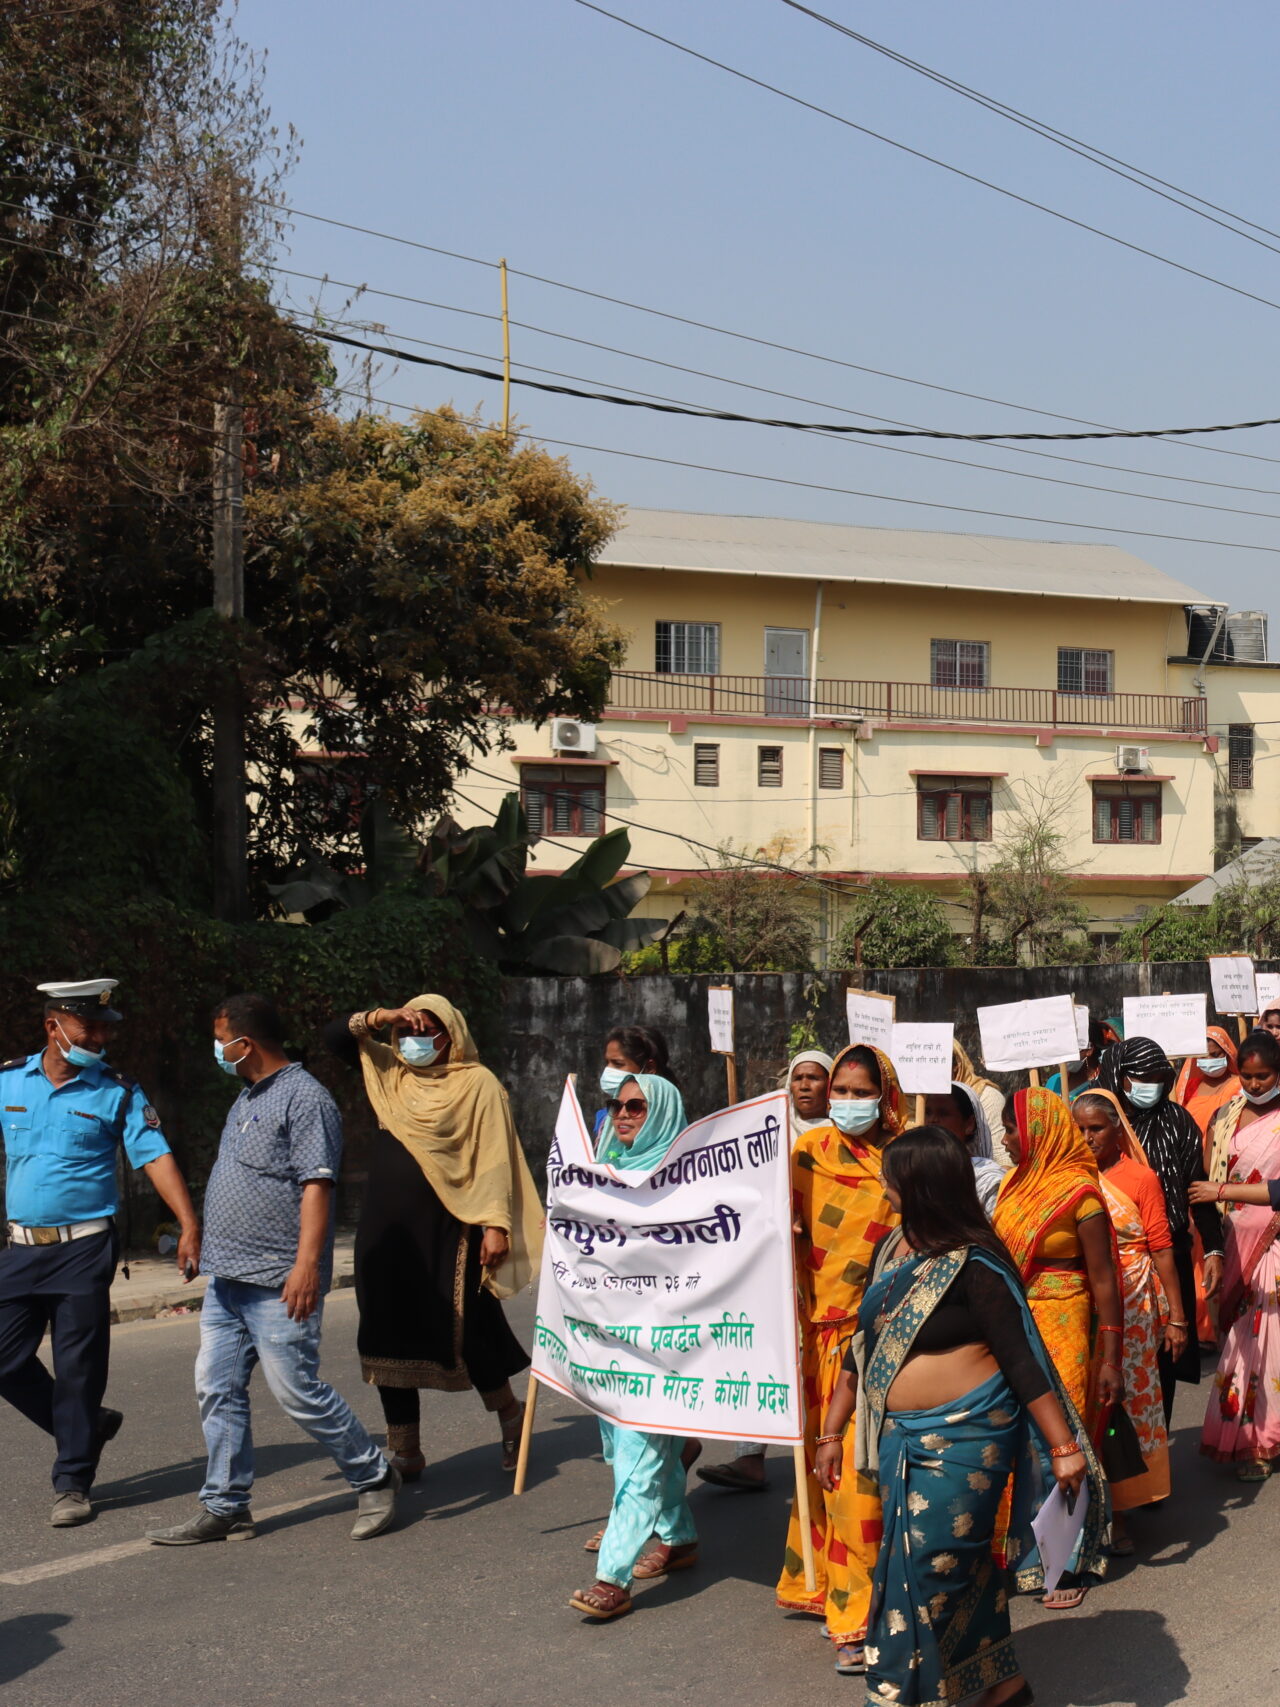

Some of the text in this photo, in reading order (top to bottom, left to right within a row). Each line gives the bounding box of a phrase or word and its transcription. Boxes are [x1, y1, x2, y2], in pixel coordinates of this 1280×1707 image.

[664, 1275, 680, 1293] २६
[709, 1311, 755, 1350] समिति
[715, 1370, 751, 1411] कोशी
[757, 1374, 790, 1414] प्रदेश
